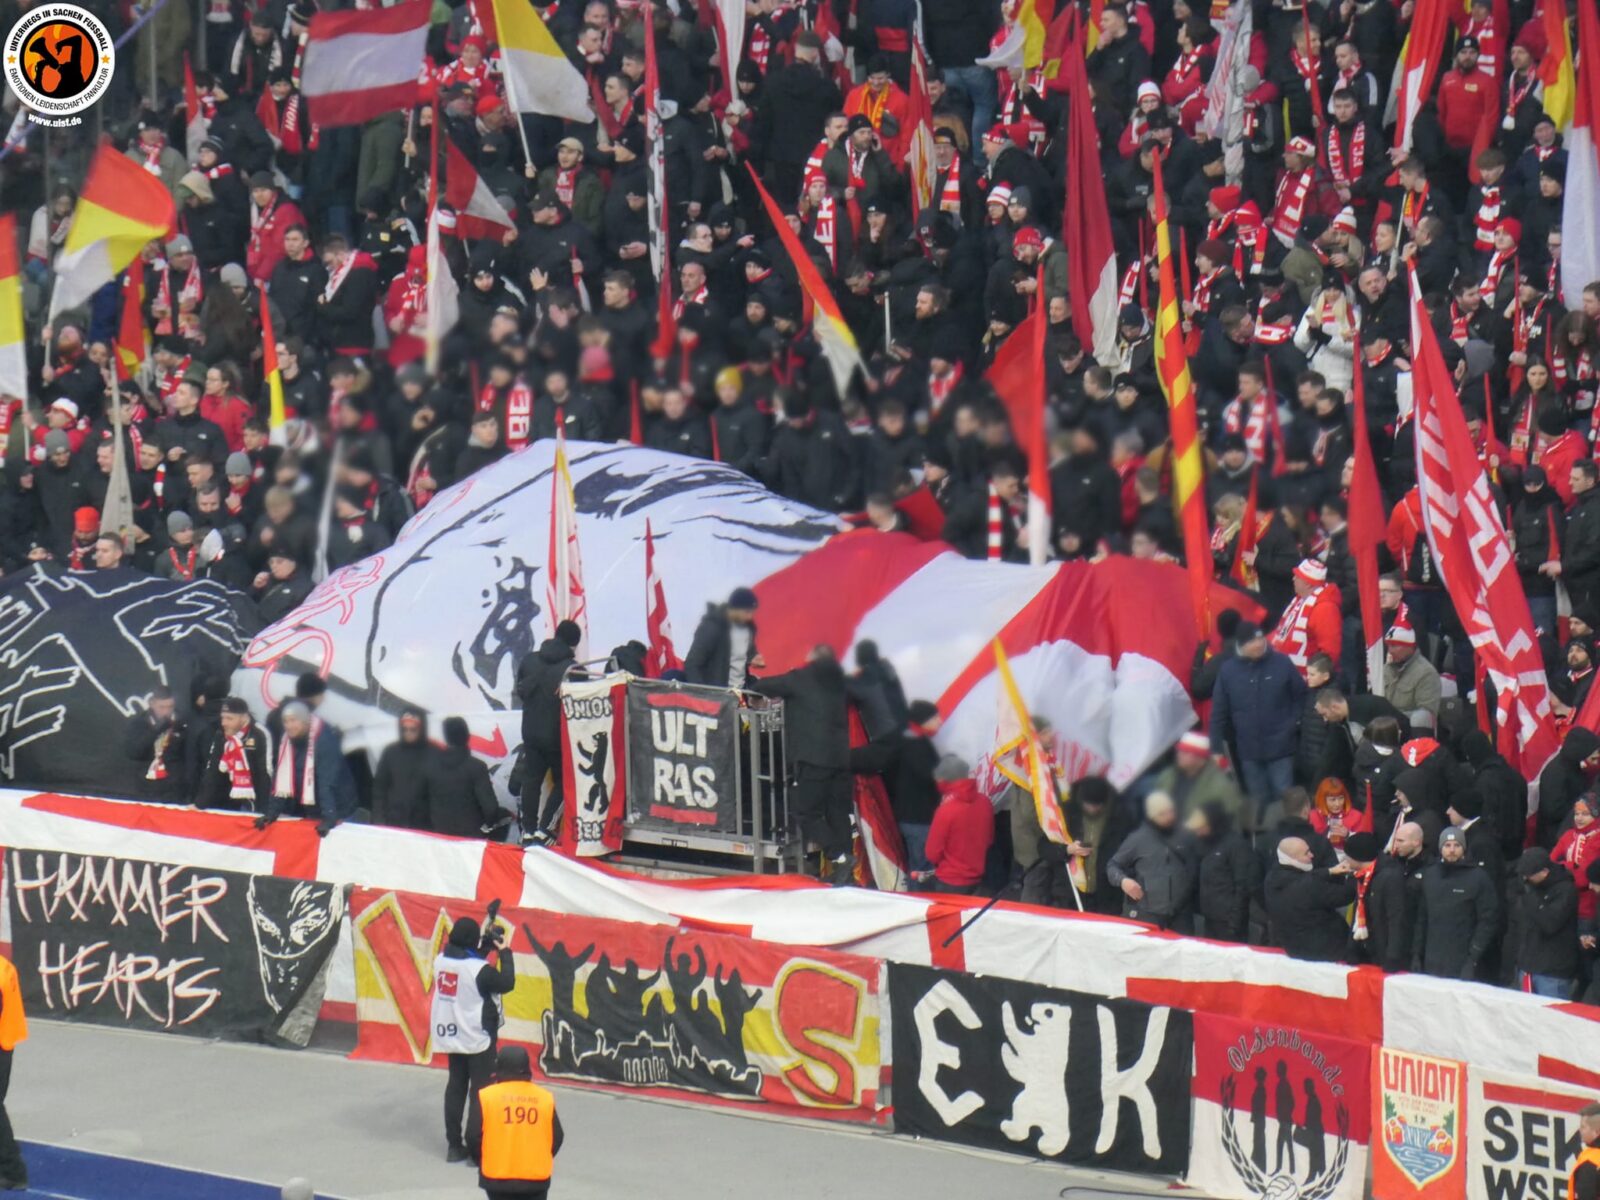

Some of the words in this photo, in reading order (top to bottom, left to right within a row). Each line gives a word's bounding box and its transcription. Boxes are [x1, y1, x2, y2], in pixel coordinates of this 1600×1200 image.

[651, 709, 718, 758] ULT
[652, 757, 719, 809] RAS
[12, 851, 229, 943] HAMMER
[38, 940, 221, 1029] HEARTS
[436, 1023, 458, 1037] 09
[1227, 1026, 1345, 1097] Olsenbande
[1383, 1052, 1457, 1104] UNION
[503, 1106, 539, 1125] 190
